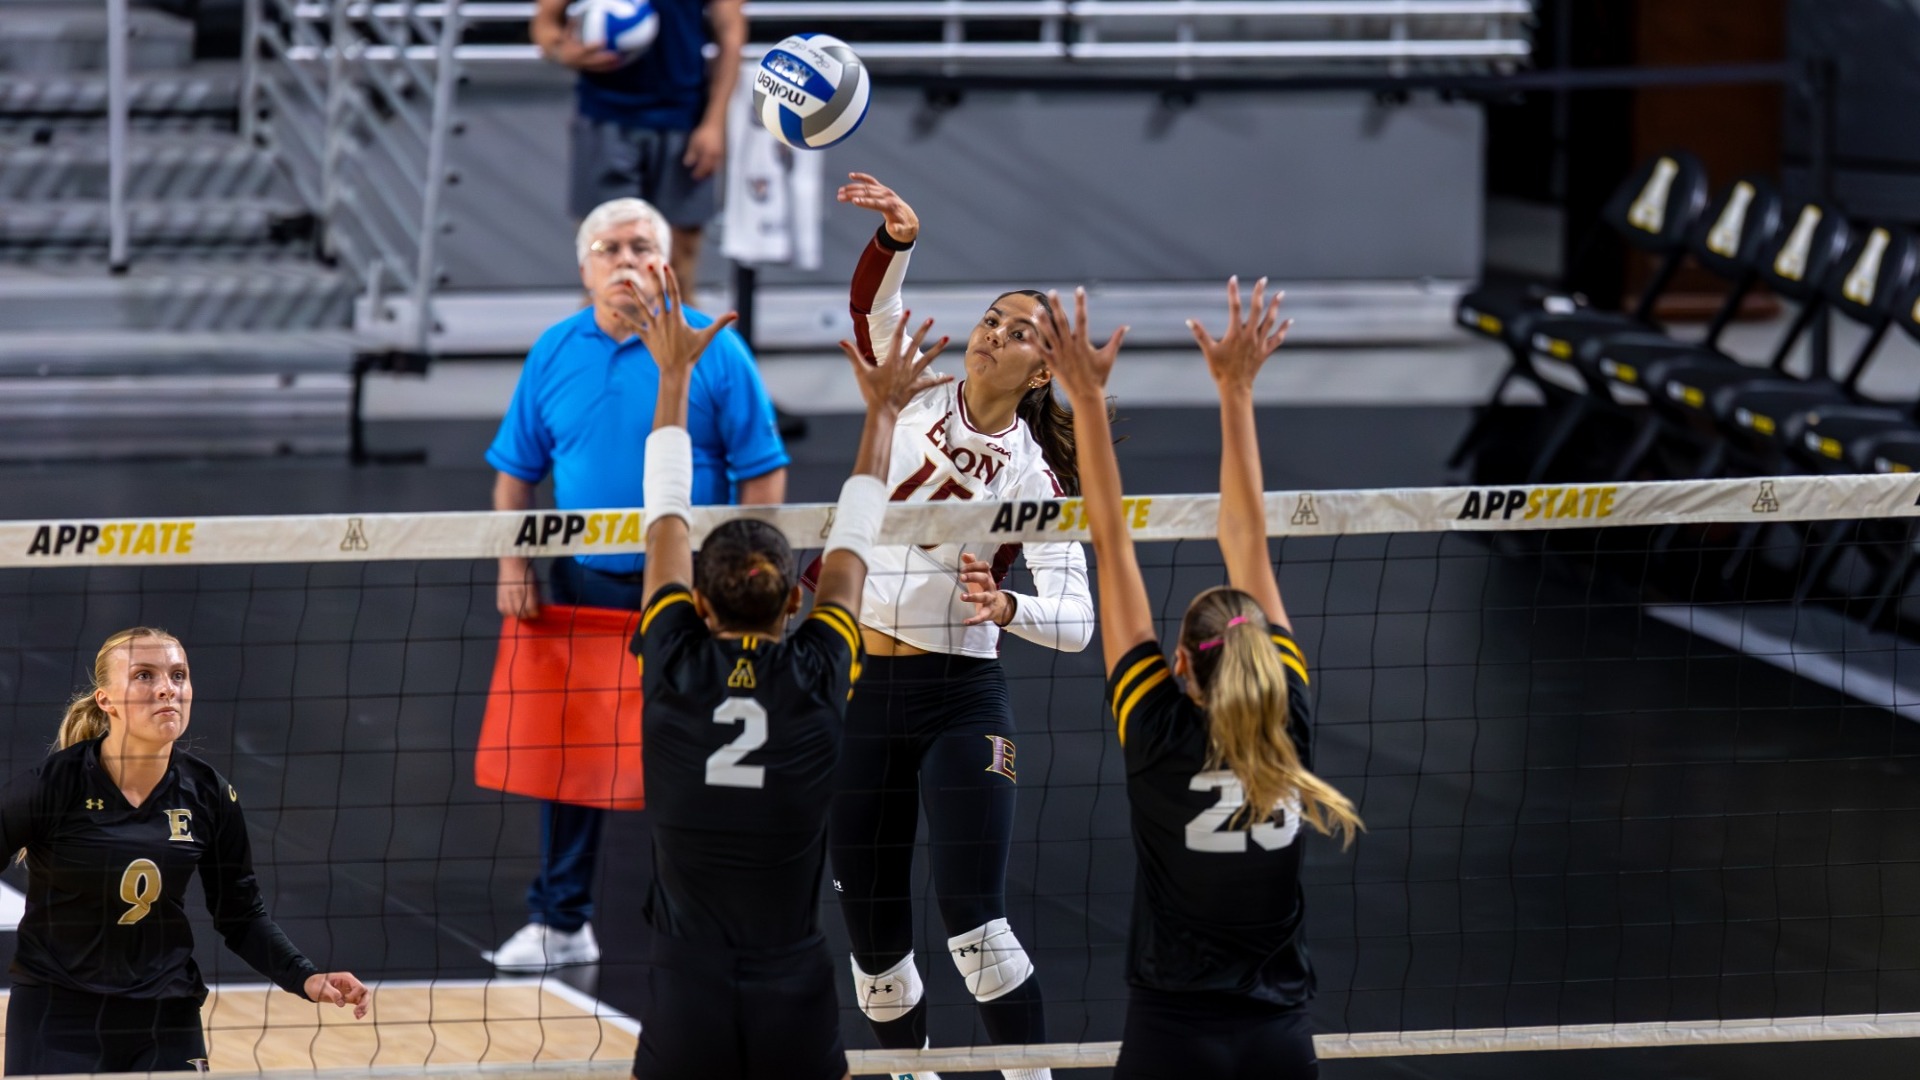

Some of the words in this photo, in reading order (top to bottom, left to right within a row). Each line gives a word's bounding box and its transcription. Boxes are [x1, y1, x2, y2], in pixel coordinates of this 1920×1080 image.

[757, 70, 807, 106] molten
[926, 411, 1004, 486] ELON
[705, 696, 768, 789] 2
[984, 734, 1017, 785] E
[163, 808, 194, 842] E
[117, 857, 162, 925] 9
